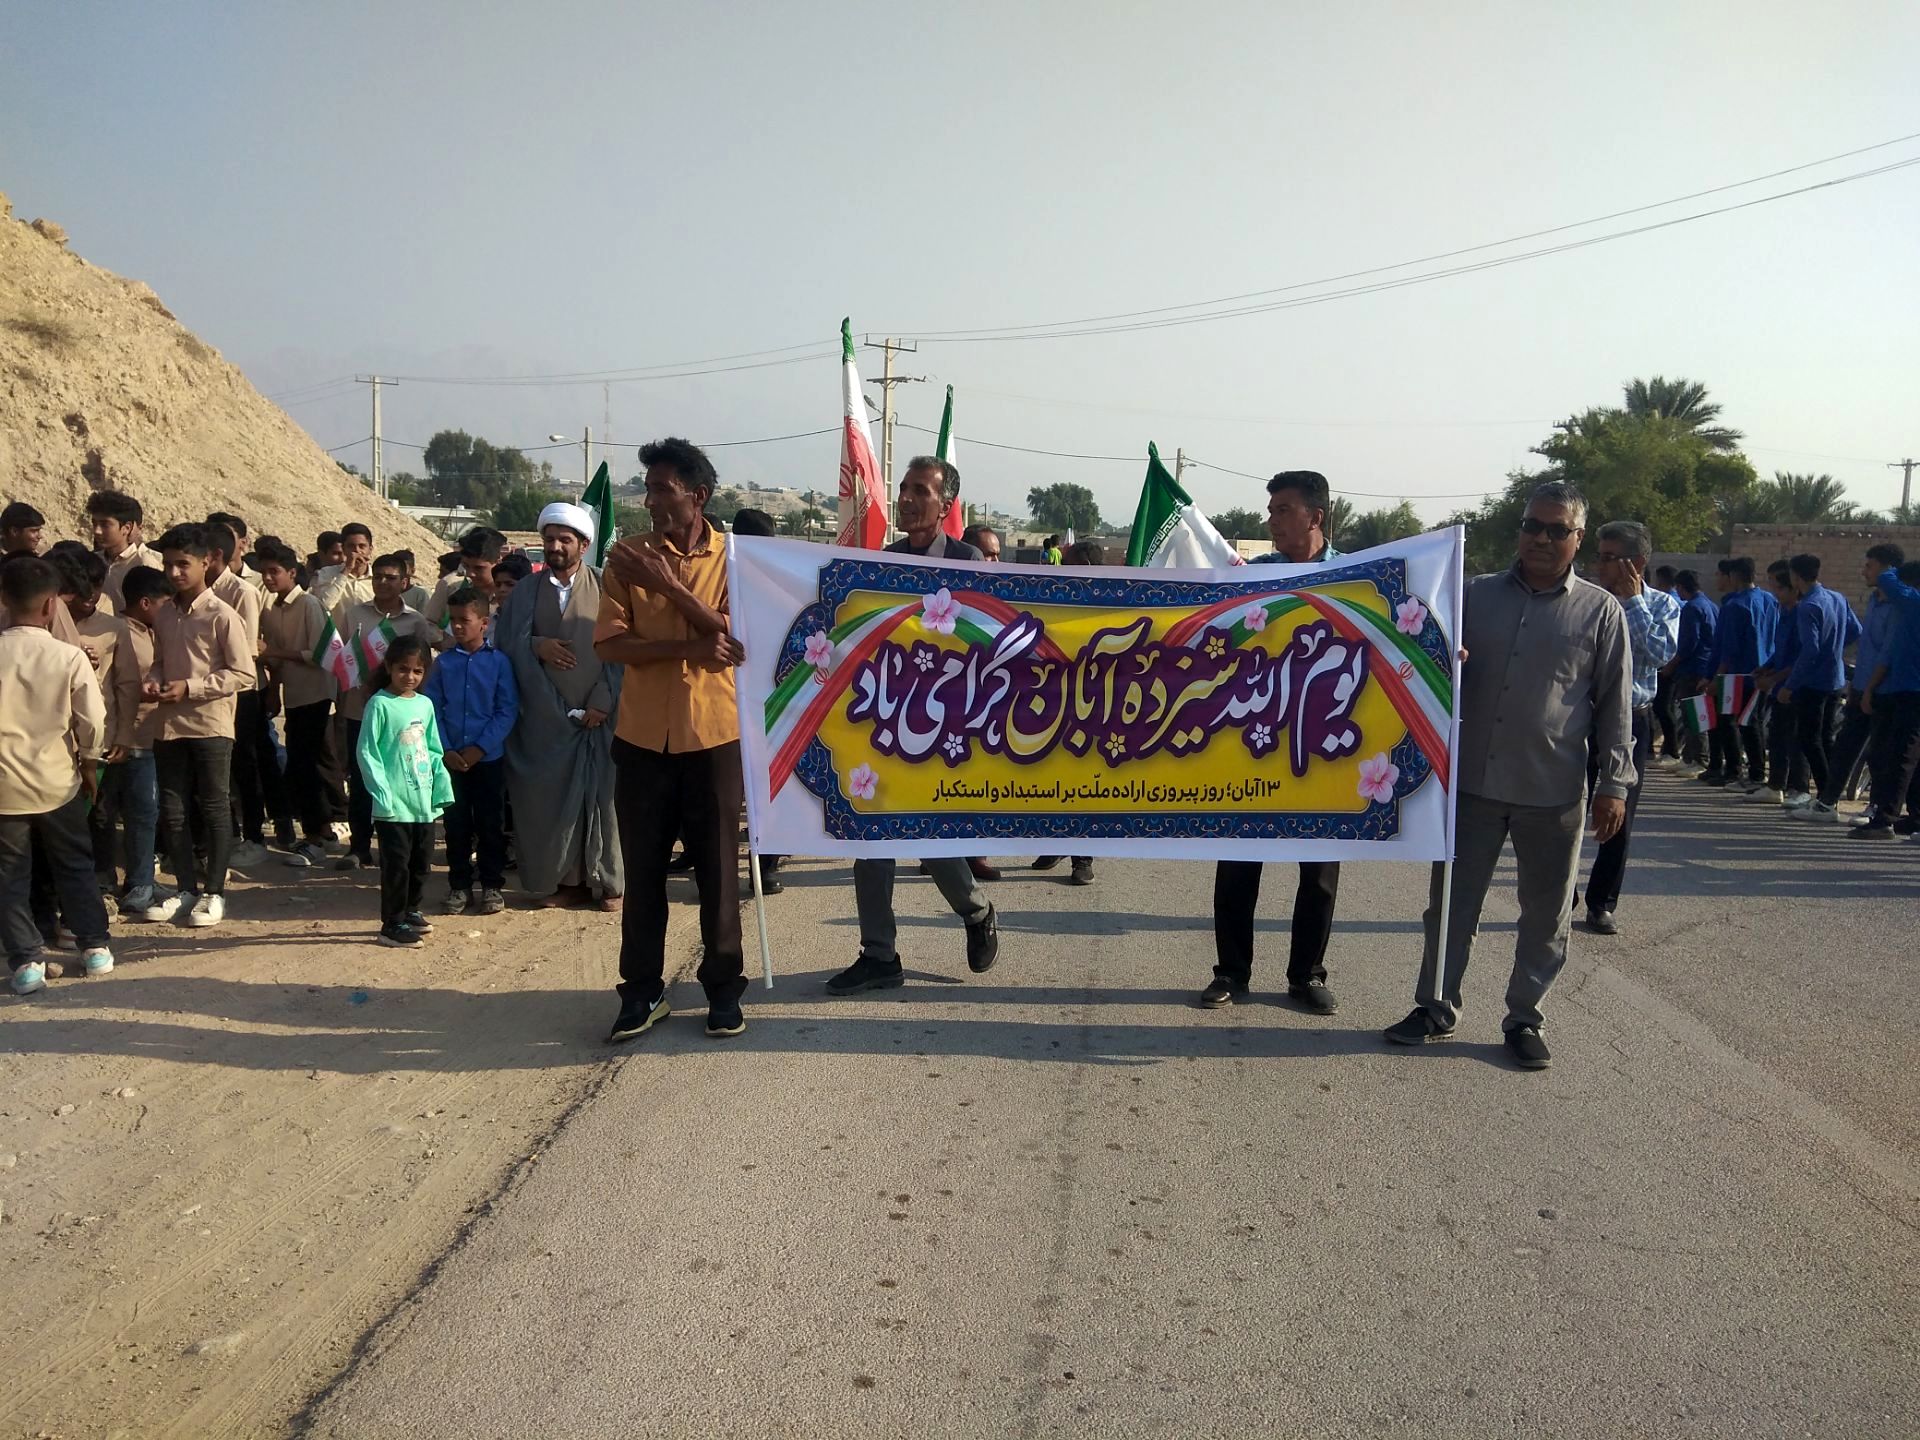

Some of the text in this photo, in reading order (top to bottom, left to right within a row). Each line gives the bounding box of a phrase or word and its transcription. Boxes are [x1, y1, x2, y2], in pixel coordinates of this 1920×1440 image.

[853, 648, 903, 748] باد
[897, 621, 1037, 755] گرامی
[1005, 622, 1146, 756] آبان
[1122, 654, 1241, 751] سیزده
[1297, 632, 1363, 768] یوم
[932, 780, 989, 802] استکبار
[990, 786, 999, 803] و
[1001, 780, 1060, 803] استبداد
[1060, 783, 1076, 803] بر
[1111, 780, 1146, 802] اراده
[1146, 783, 1199, 804] پیروزی
[1200, 783, 1225, 802] روز
